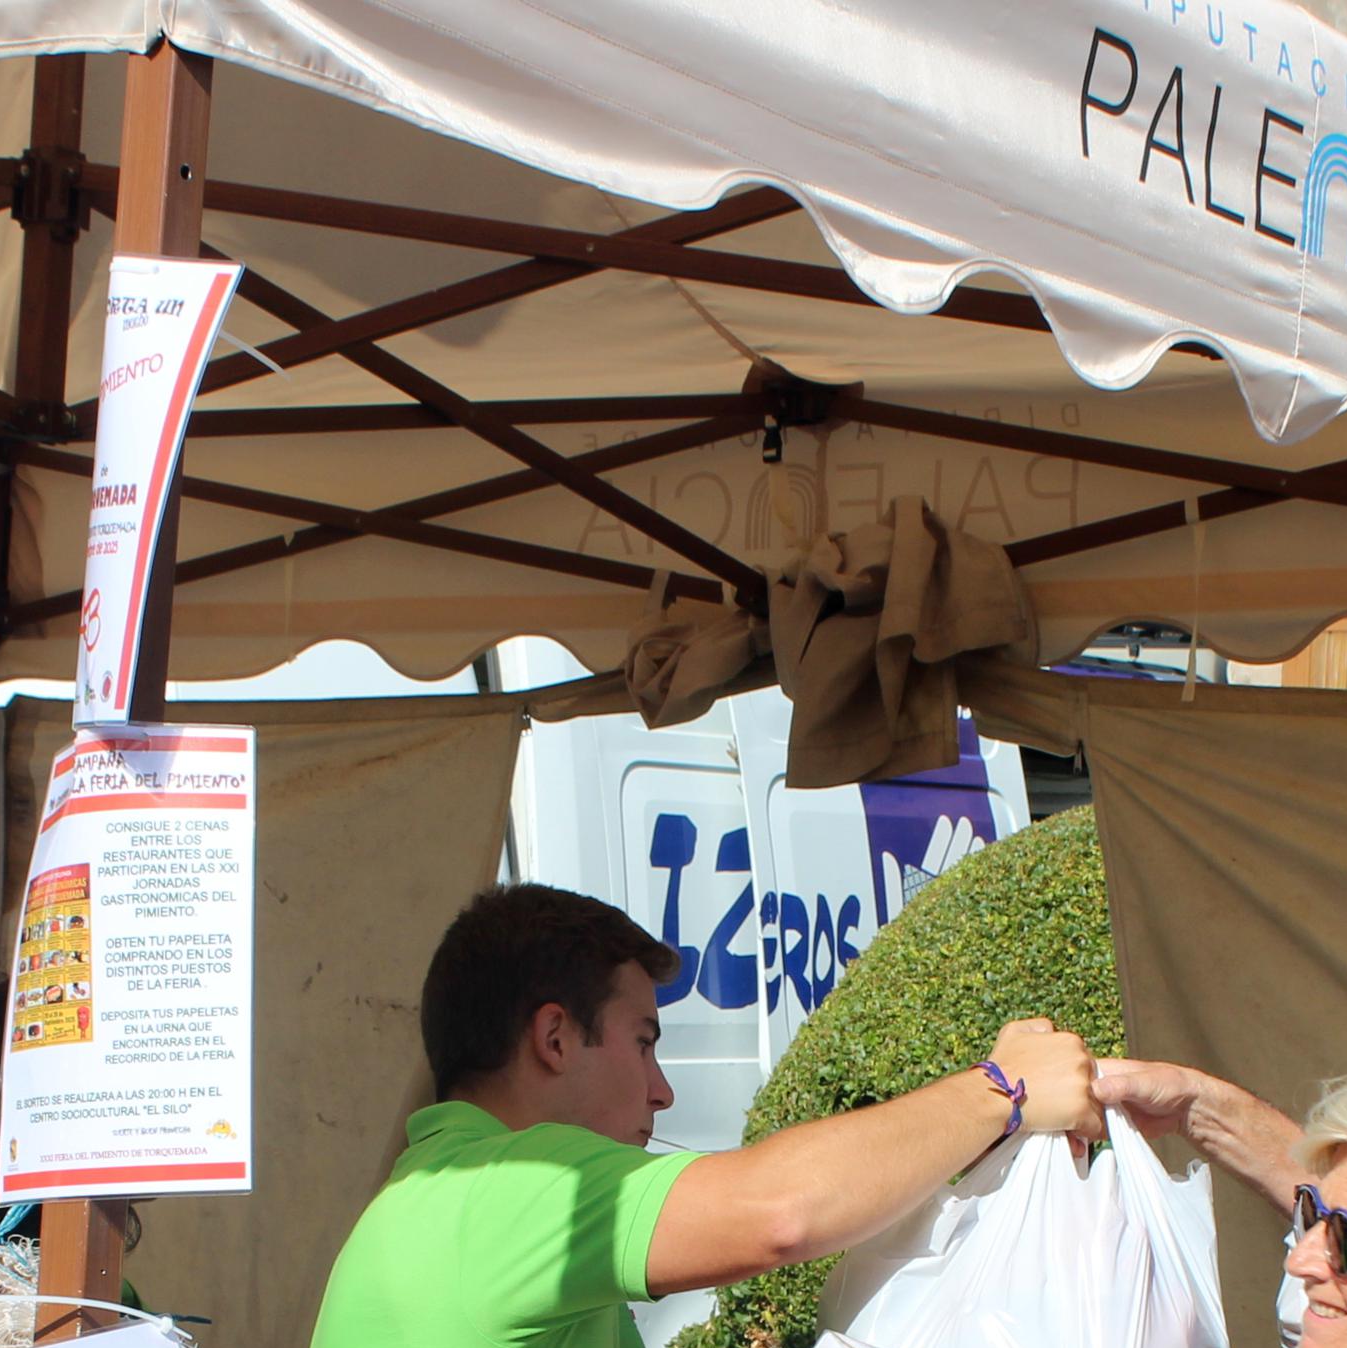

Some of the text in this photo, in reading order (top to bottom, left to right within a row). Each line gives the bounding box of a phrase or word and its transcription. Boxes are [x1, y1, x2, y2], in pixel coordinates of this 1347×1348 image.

[135, 771, 162, 789] DEL
[106, 821, 229, 833] CONSIGUE 2 CENAS
[131, 835, 202, 847] ENTRE LOS
[103, 849, 233, 862] RESTAURANTES QUE
[97, 863, 239, 877] PARTICIPAN EN LAS XXI
[132, 877, 200, 889] JORNADAS
[101, 891, 236, 906] GASTRONOMICAS DEL
[135, 906, 198, 918] PIMIENTO.
[106, 934, 232, 949] OBTEN TU PAPELETA
[105, 948, 232, 963] COMPRANDO EN LOS
[106, 963, 231, 978] DISTINTOS PUESTOS
[128, 978, 202, 991] DE LA FERIA
[101, 1007, 239, 1022] DEPOSITA TUS PAPELETAS
[124, 1021, 212, 1034] EN LA URNA QUE
[112, 1036, 226, 1050] ENCONTRARAS EN EL
[105, 1050, 235, 1064] RECORRIDO DE LA FERIA
[16, 1087, 222, 1110] EL SORTEO SE REALIZARA A LAS 20:00 H EN EL
[30, 1111, 59, 1123] CENTRO
[61, 1106, 141, 1121] SOCIOCULTURAL
[54, 1154, 73, 1162] FERIA
[74, 1152, 88, 1161] DEL
[90, 1150, 130, 1160] PIMIENTO
[131, 1149, 143, 1157] DE
[145, 1147, 208, 1157] TORQUEMADA
